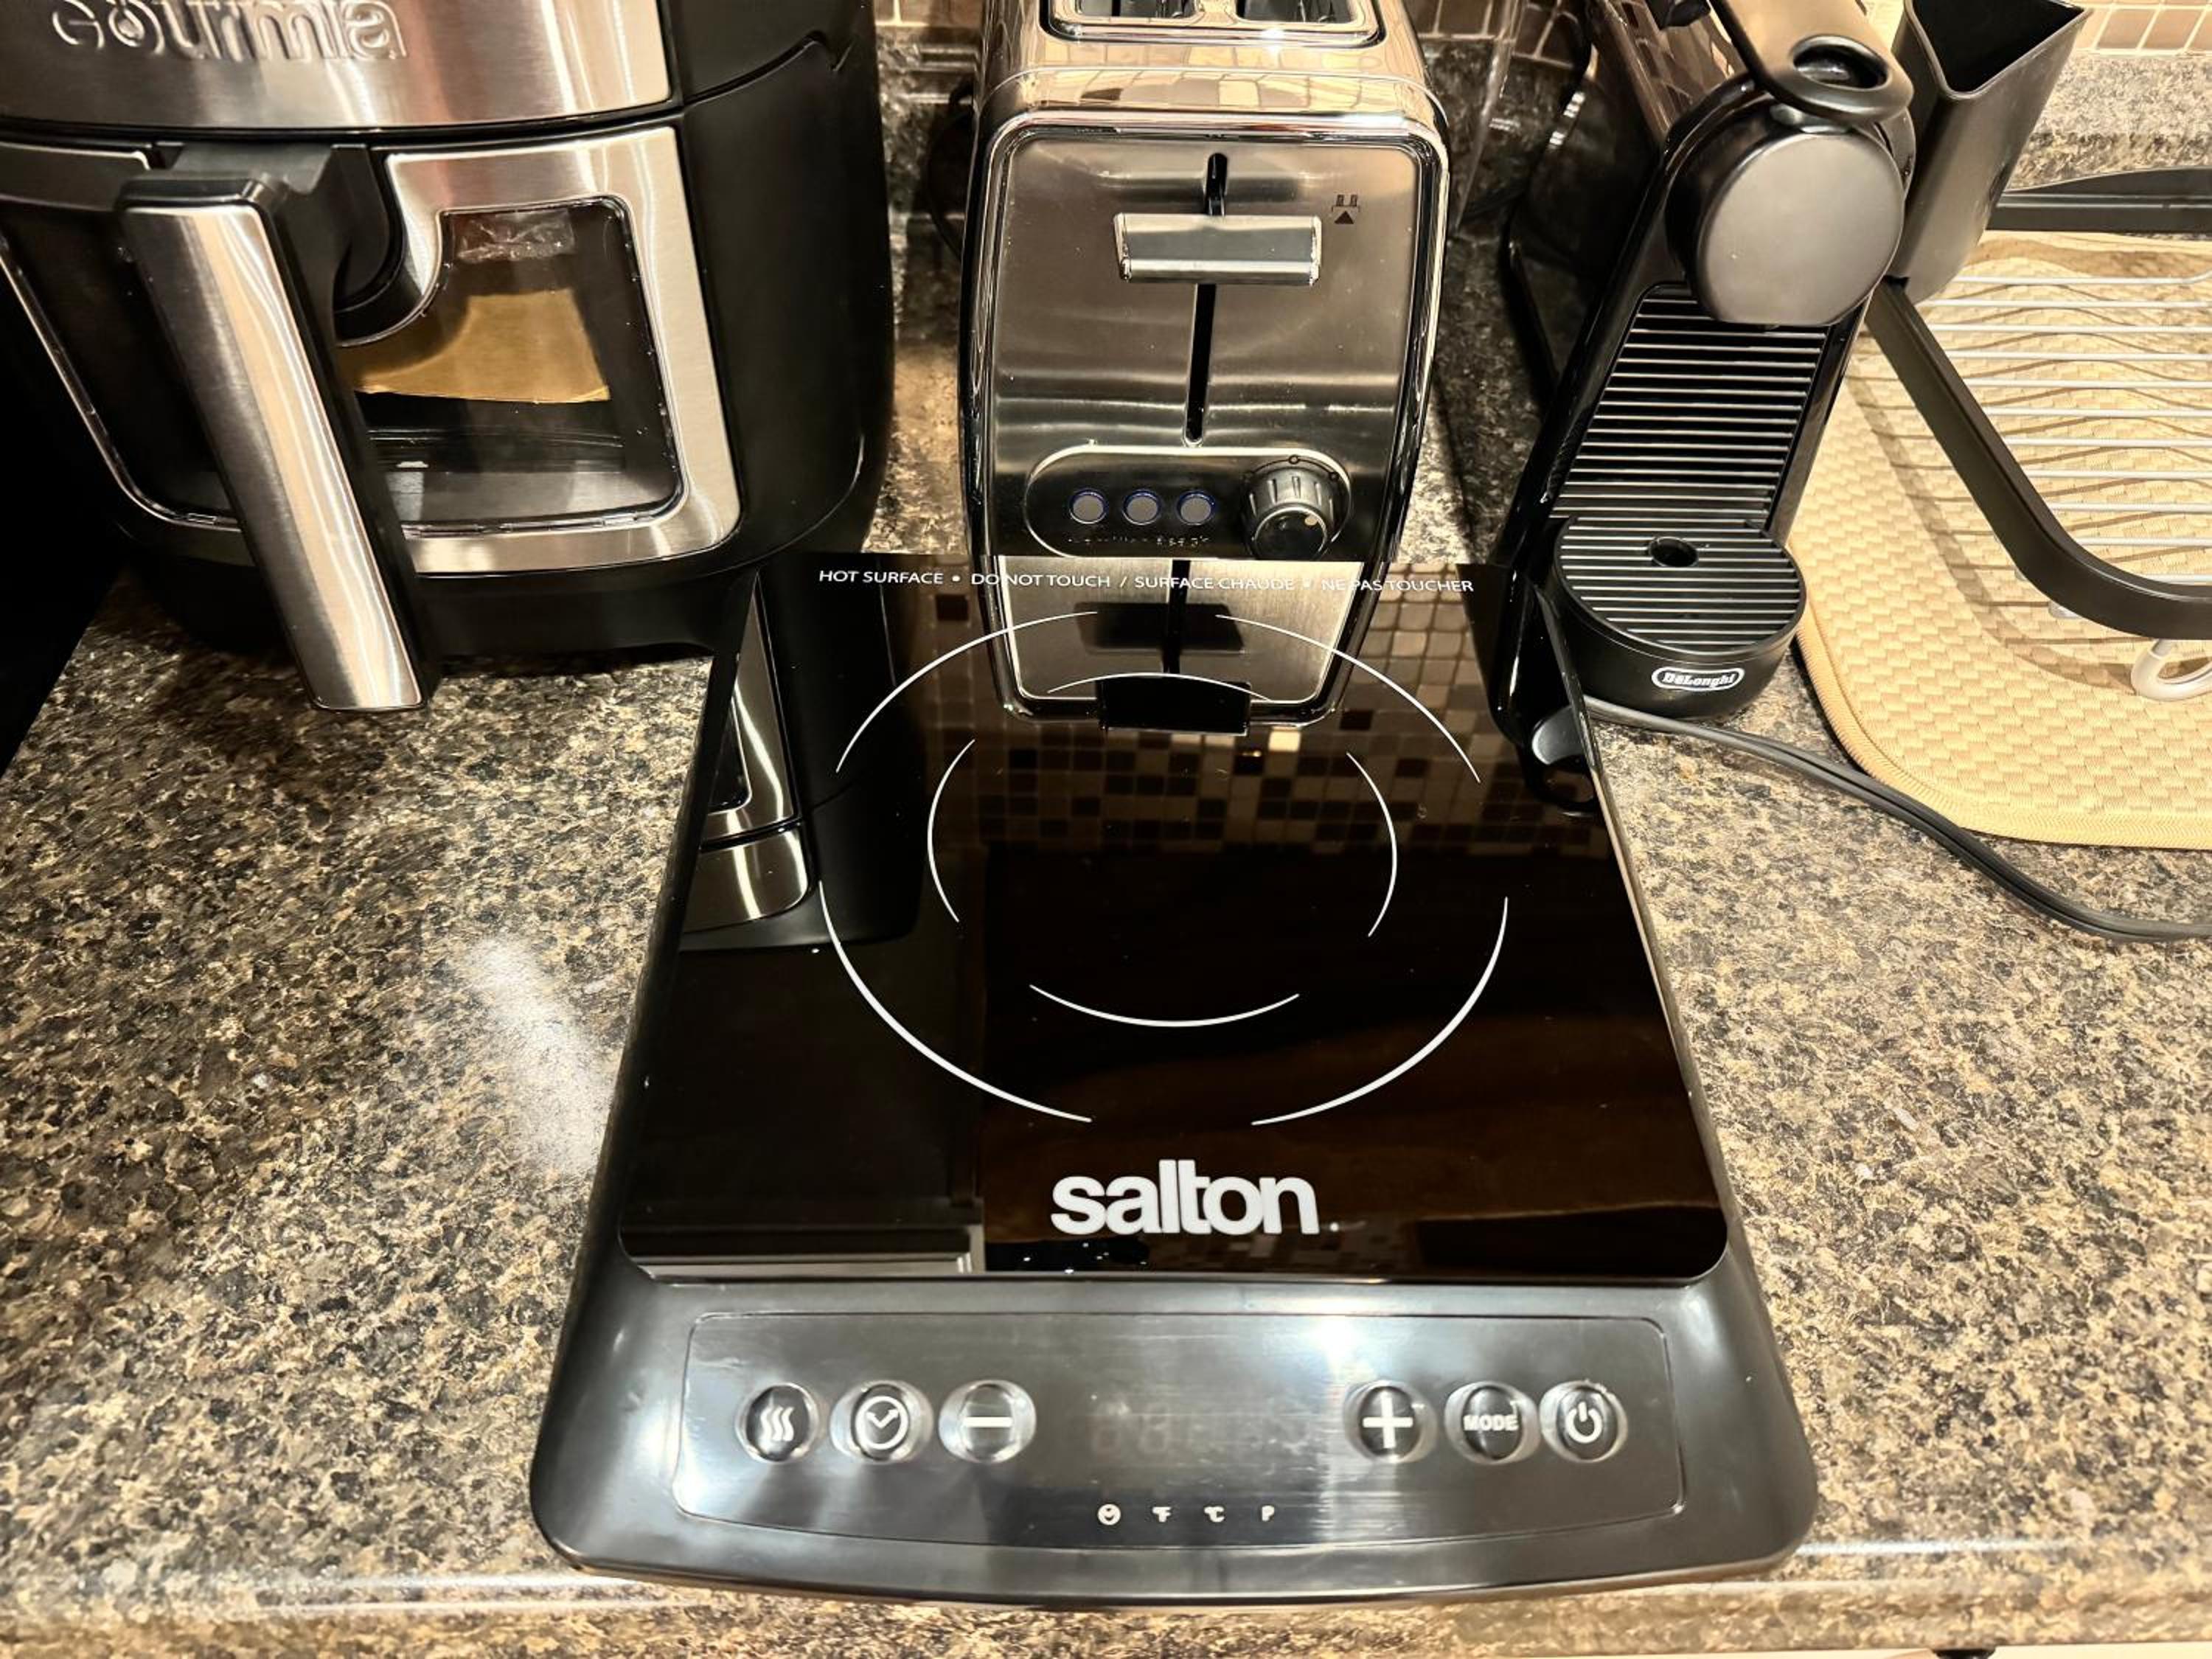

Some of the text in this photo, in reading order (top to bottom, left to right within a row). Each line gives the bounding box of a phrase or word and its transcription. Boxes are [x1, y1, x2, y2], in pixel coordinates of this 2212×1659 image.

[818, 570, 859, 582] HOT
[862, 571, 944, 585] SURFACE
[971, 573, 999, 585] DO
[1004, 574, 1043, 586] NOT
[1045, 574, 1110, 588] TOUCH
[1135, 577, 1214, 590] SURFACE
[1218, 577, 1295, 591] CHAUDE
[1321, 579, 1346, 591] NE
[1352, 580, 1383, 591] PAS
[1382, 580, 1475, 592] TOUCHER
[1051, 1159, 1320, 1235] salton
[1463, 1413, 1519, 1431] MODE
[1262, 1505, 1275, 1522] P
